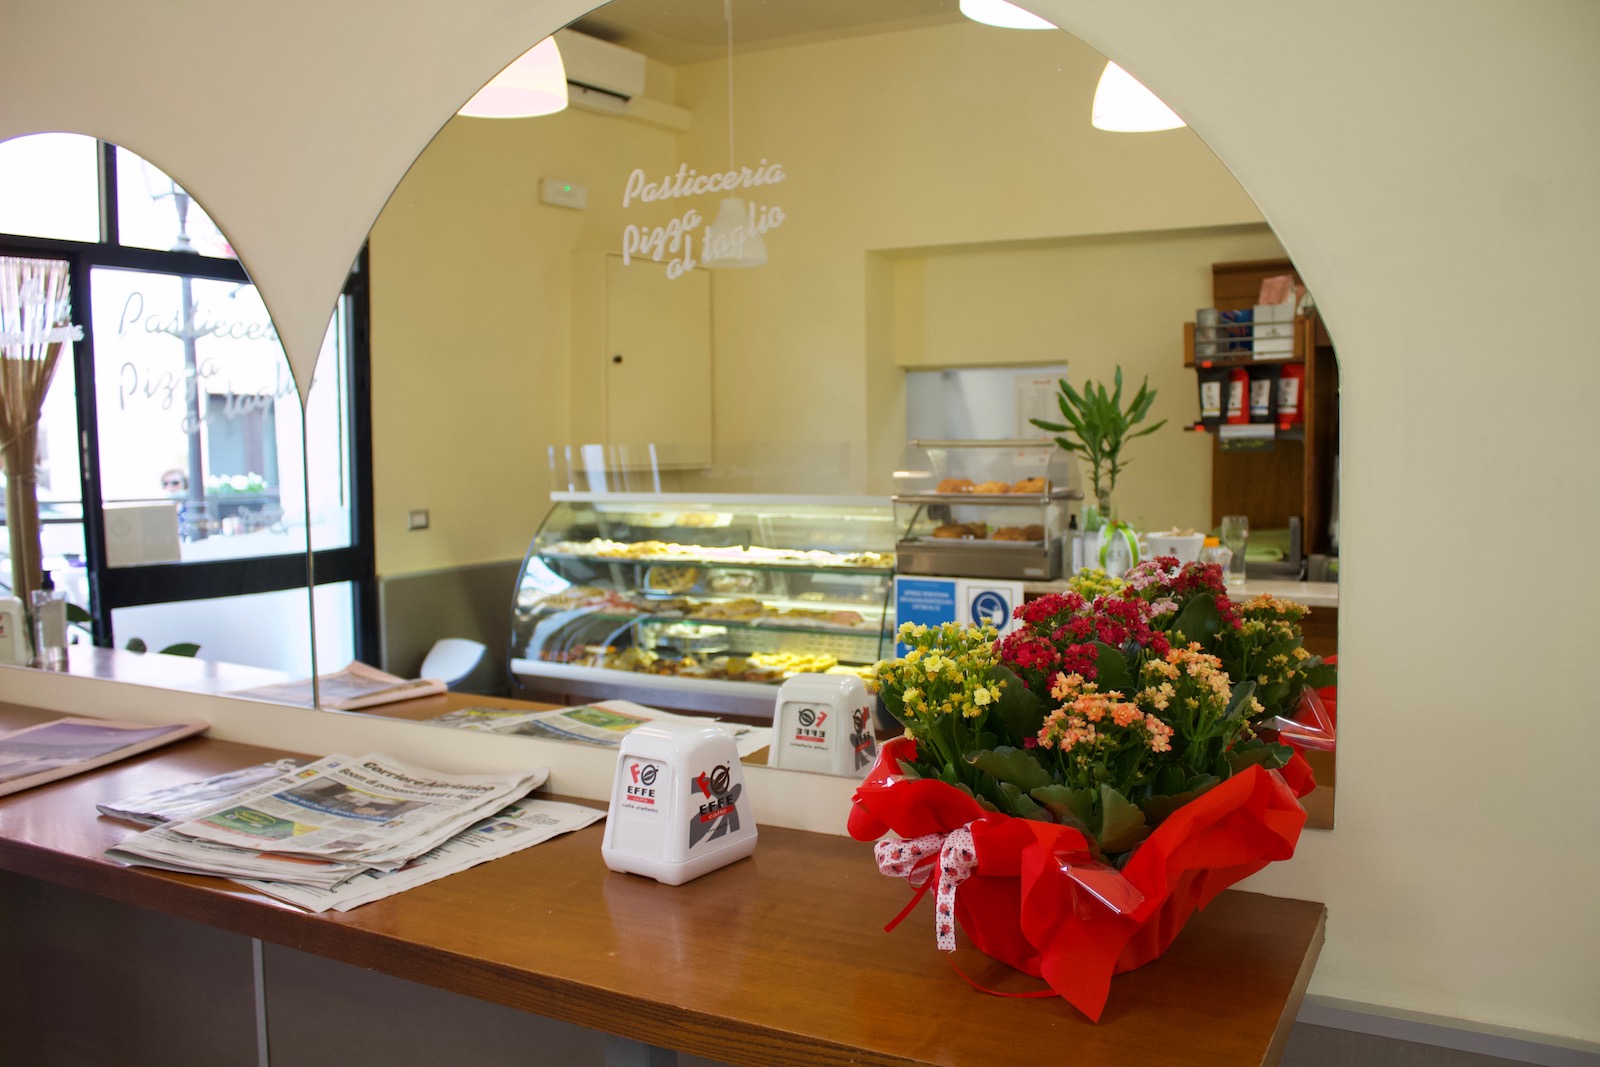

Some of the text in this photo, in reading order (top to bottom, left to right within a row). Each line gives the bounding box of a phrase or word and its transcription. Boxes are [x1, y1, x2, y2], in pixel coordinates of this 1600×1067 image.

[622, 158, 786, 208] Pasticceria
[622, 208, 702, 266] Pizza
[666, 200, 786, 280] al taglio
[363, 761, 425, 786] Corriere
[627, 785, 656, 798] EFFE
[699, 794, 733, 816] EFFE
